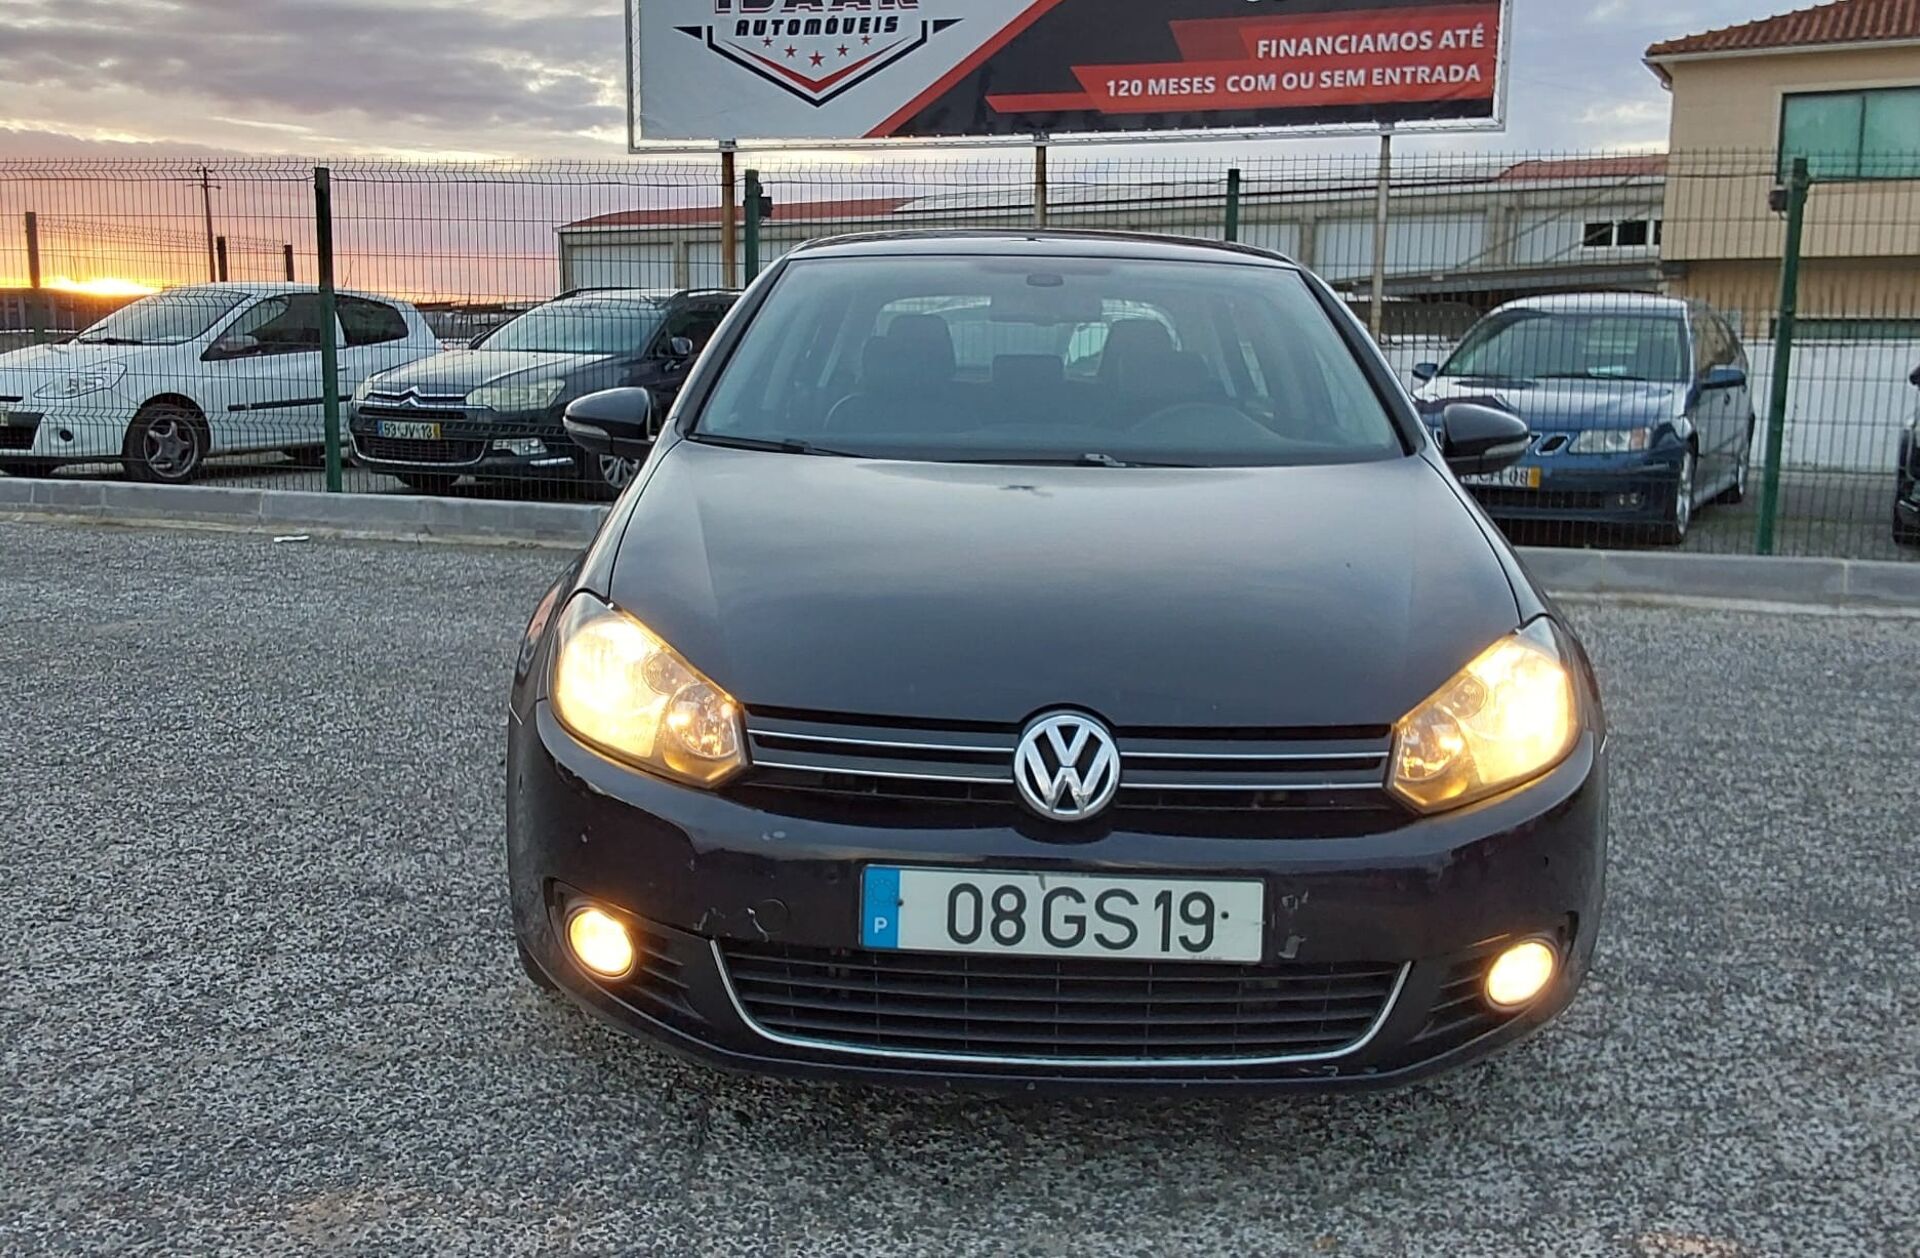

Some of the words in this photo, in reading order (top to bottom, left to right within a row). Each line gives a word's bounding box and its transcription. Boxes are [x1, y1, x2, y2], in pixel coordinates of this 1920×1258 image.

[735, 15, 899, 36] AUTOMÓVEIS
[1257, 31, 1433, 57] FINANCIAMOS
[1438, 23, 1485, 49] ATÉ
[1106, 79, 1142, 97] 120
[1147, 76, 1216, 96] MESES
[1226, 73, 1277, 92] COM
[1281, 70, 1315, 90] OU
[1319, 68, 1367, 88] SEM
[1371, 64, 1481, 86] ENTRADA
[874, 917, 888, 933] P
